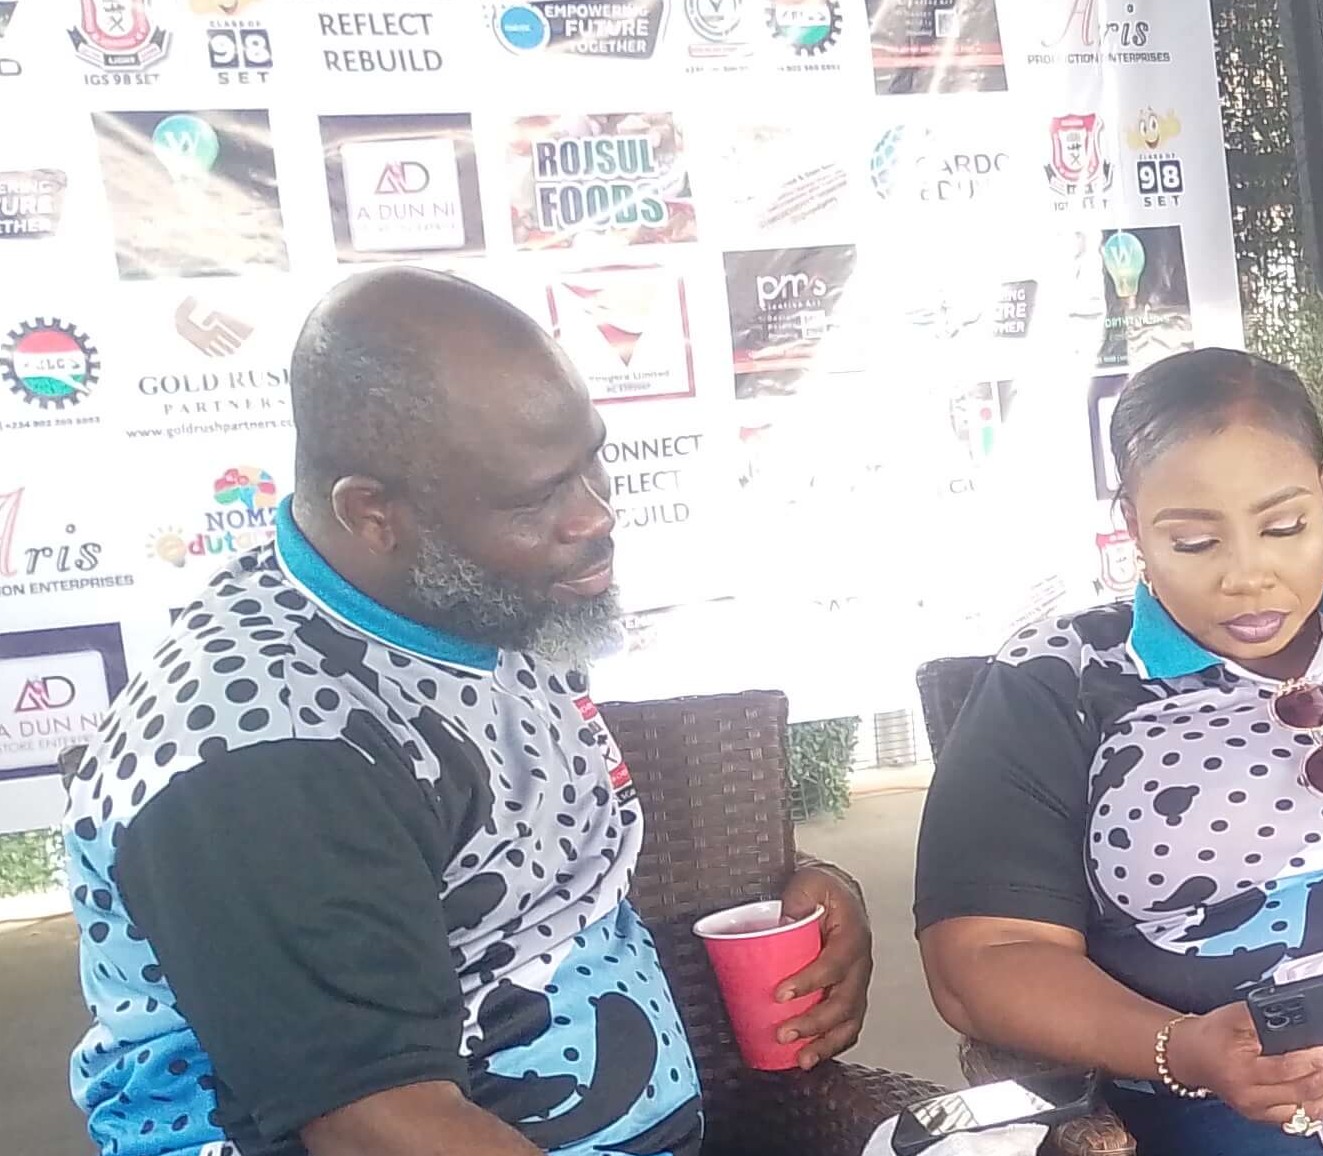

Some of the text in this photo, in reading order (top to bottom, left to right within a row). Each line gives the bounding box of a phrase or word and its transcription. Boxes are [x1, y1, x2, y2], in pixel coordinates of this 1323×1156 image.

[318, 12, 434, 36] REFLECT
[565, 19, 649, 37] FUTURE
[208, 32, 272, 66] 98
[323, 49, 443, 72] REBUILD
[1108, 52, 1171, 63] NTERPRISES
[84, 74, 109, 86] IGS
[136, 73, 160, 85] SET
[217, 71, 270, 85] SET
[536, 139, 655, 177] ROJSUL
[1138, 162, 1182, 192] 98
[539, 184, 665, 228] FOODS
[1144, 195, 1181, 208] SET
[138, 373, 219, 396] GOLD
[601, 434, 704, 463] ONNECT
[613, 470, 682, 496] FLECT
[29, 574, 134, 594] ENTERPRISES
[19, 716, 72, 737] DUN
